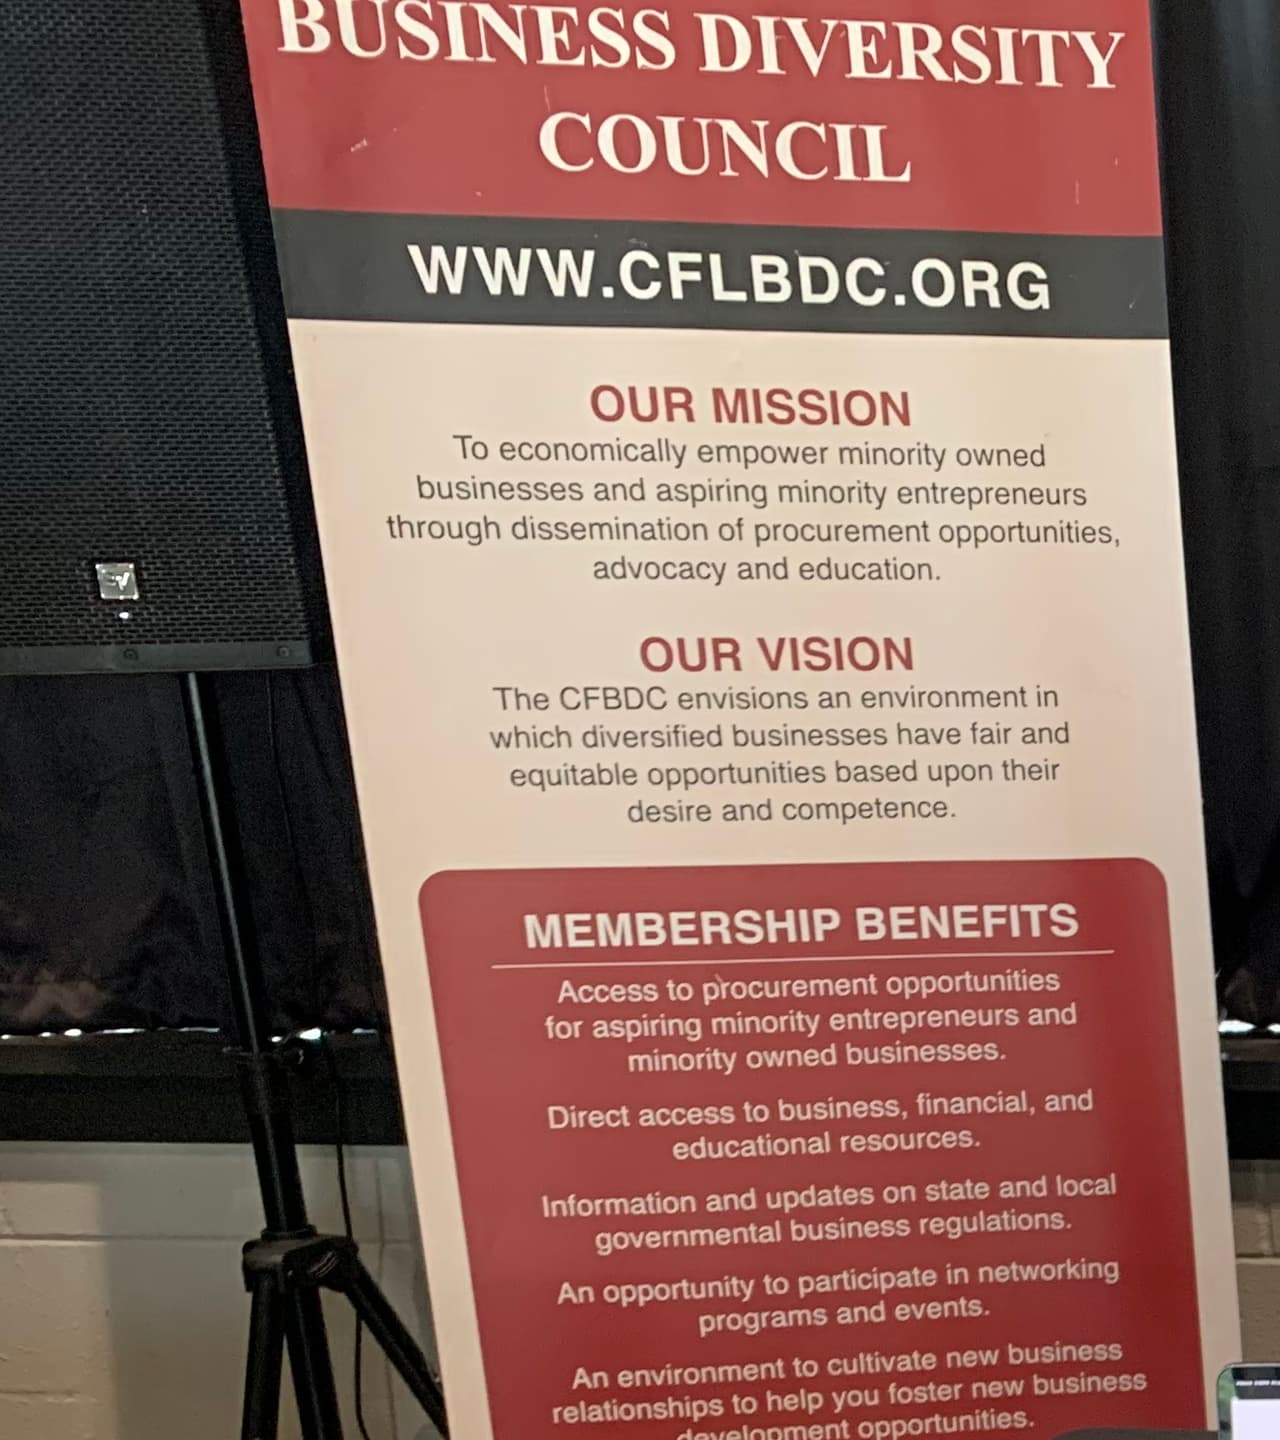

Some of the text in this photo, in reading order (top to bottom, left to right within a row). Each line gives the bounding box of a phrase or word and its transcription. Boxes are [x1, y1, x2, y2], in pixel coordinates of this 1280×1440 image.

[278, 0, 1125, 88] BUSINESS DIVERSITY
[539, 112, 911, 182] COUNCIL
[407, 245, 1050, 310] WWW.CFLBDC.ORG
[591, 385, 911, 427] OUR MISSION
[452, 435, 1046, 472] To economically empower minority owned
[416, 474, 1087, 511] businesses and aspiring minority entrepreneurs
[386, 514, 1119, 549] through dissemination of procurement opportunities,
[593, 556, 940, 586] advocacy and education.
[640, 636, 913, 672] OUR VISION
[524, 903, 1079, 948] MEMBERSHIP BENEFITS
[542, 1173, 1116, 1218] Information and updates on state and local
[595, 1209, 1071, 1256] governmental business regulations.
[699, 1296, 990, 1338] programs and events.
